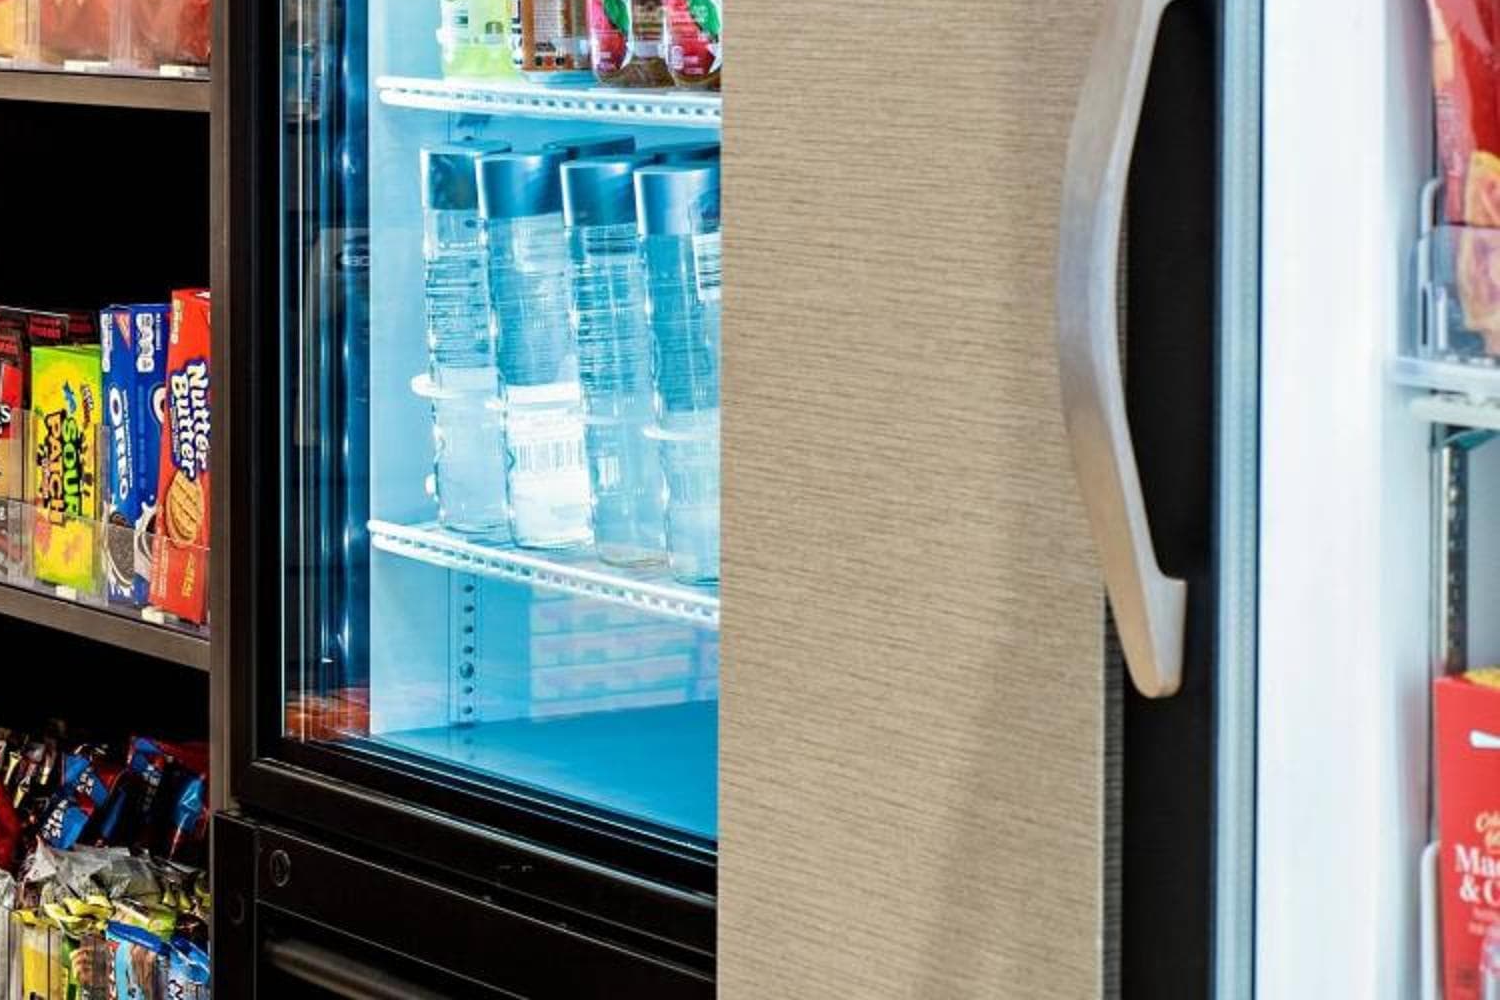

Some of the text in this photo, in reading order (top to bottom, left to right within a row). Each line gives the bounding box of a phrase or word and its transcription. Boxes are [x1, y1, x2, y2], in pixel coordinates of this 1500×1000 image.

[62, 417, 79, 518] SOUR
[109, 386, 129, 500] OREO
[171, 372, 195, 480] Butter
[186, 361, 211, 470] Nutter
